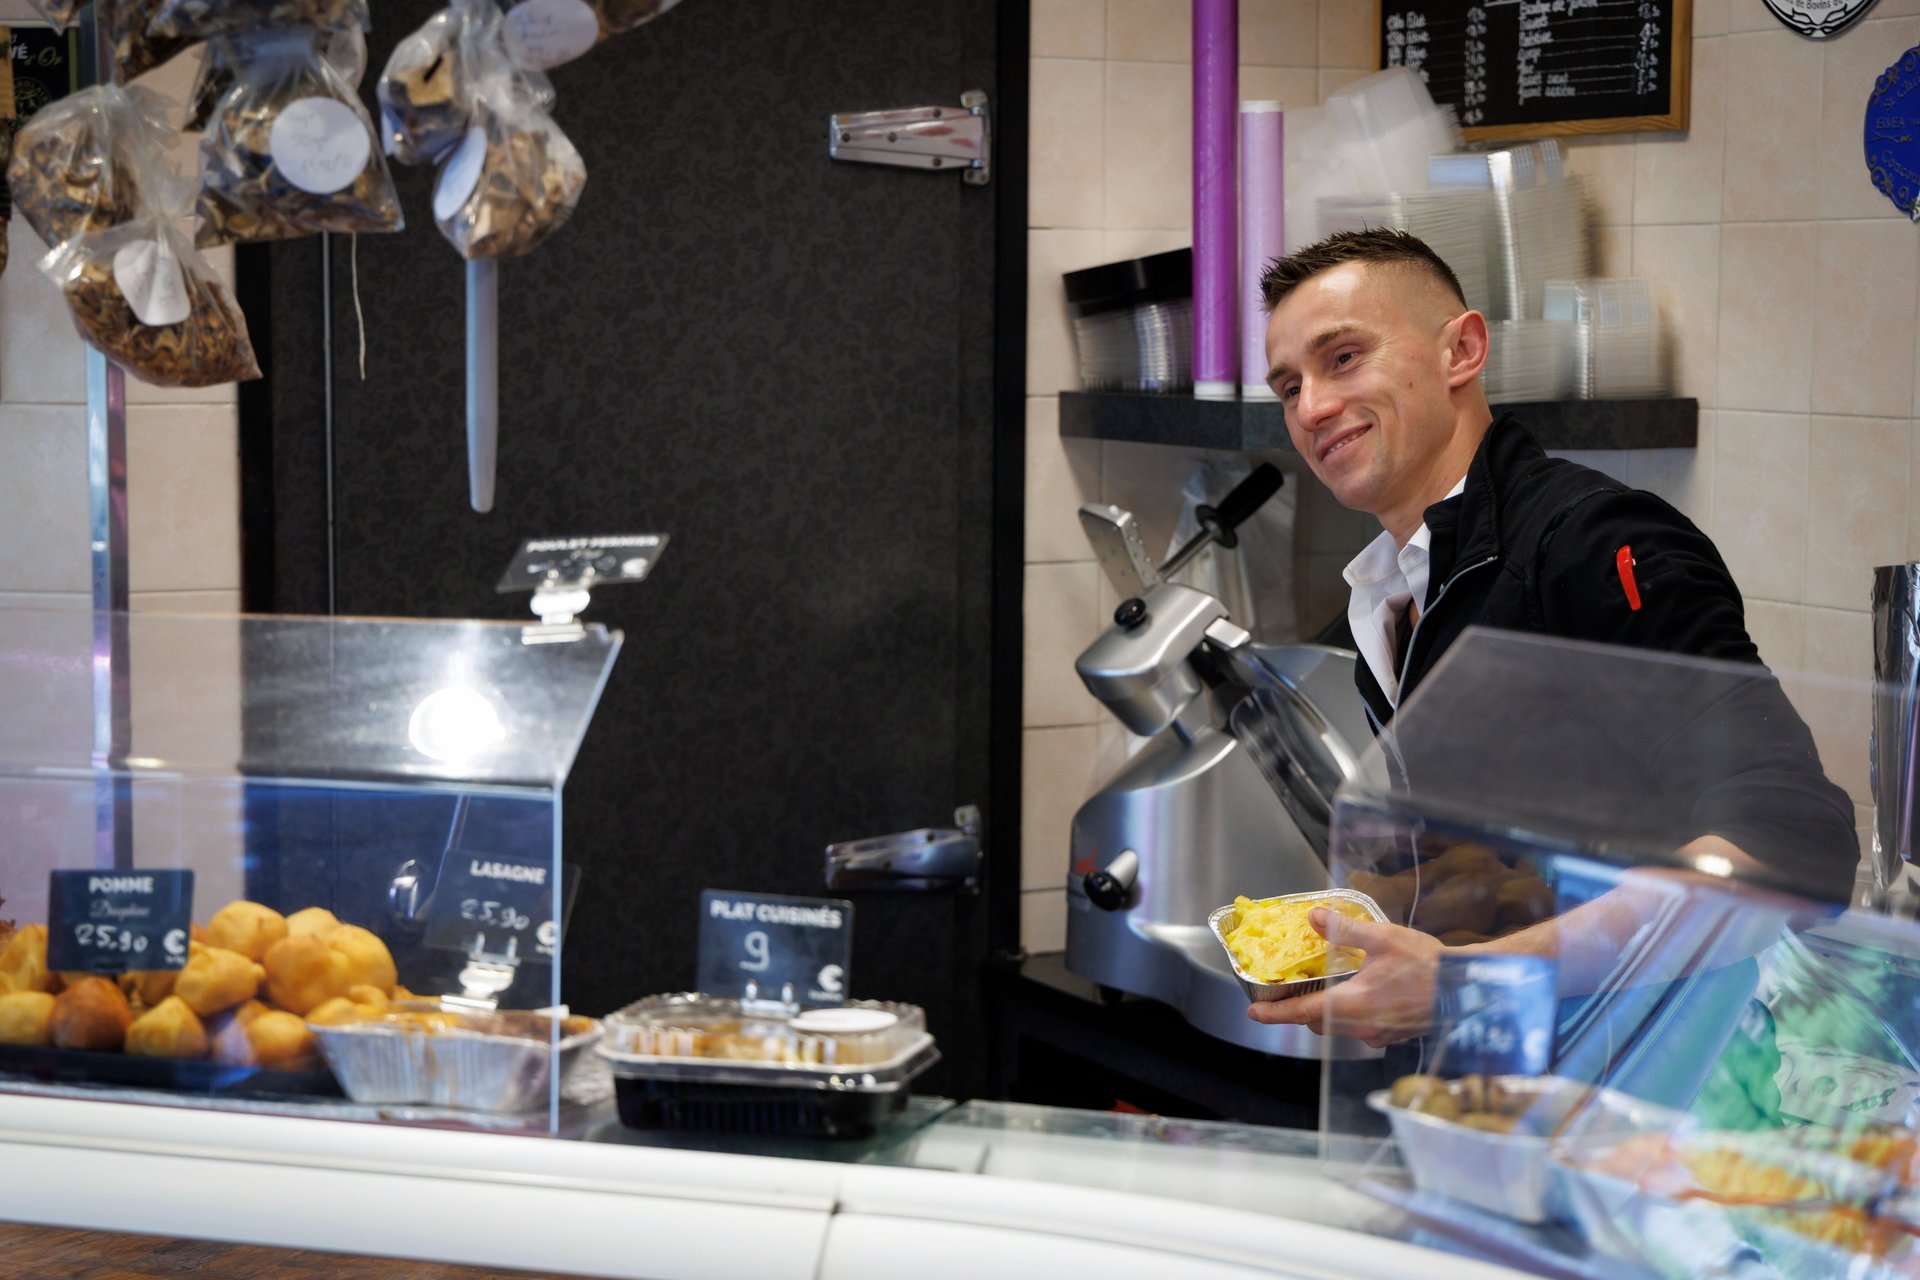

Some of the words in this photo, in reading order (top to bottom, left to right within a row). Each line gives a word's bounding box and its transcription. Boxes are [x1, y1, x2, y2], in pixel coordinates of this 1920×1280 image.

[88, 876, 156, 895] POMME
[470, 860, 548, 886] LASAGNE
[710, 898, 755, 922] PLAT
[755, 903, 843, 930] CUISINÉS
